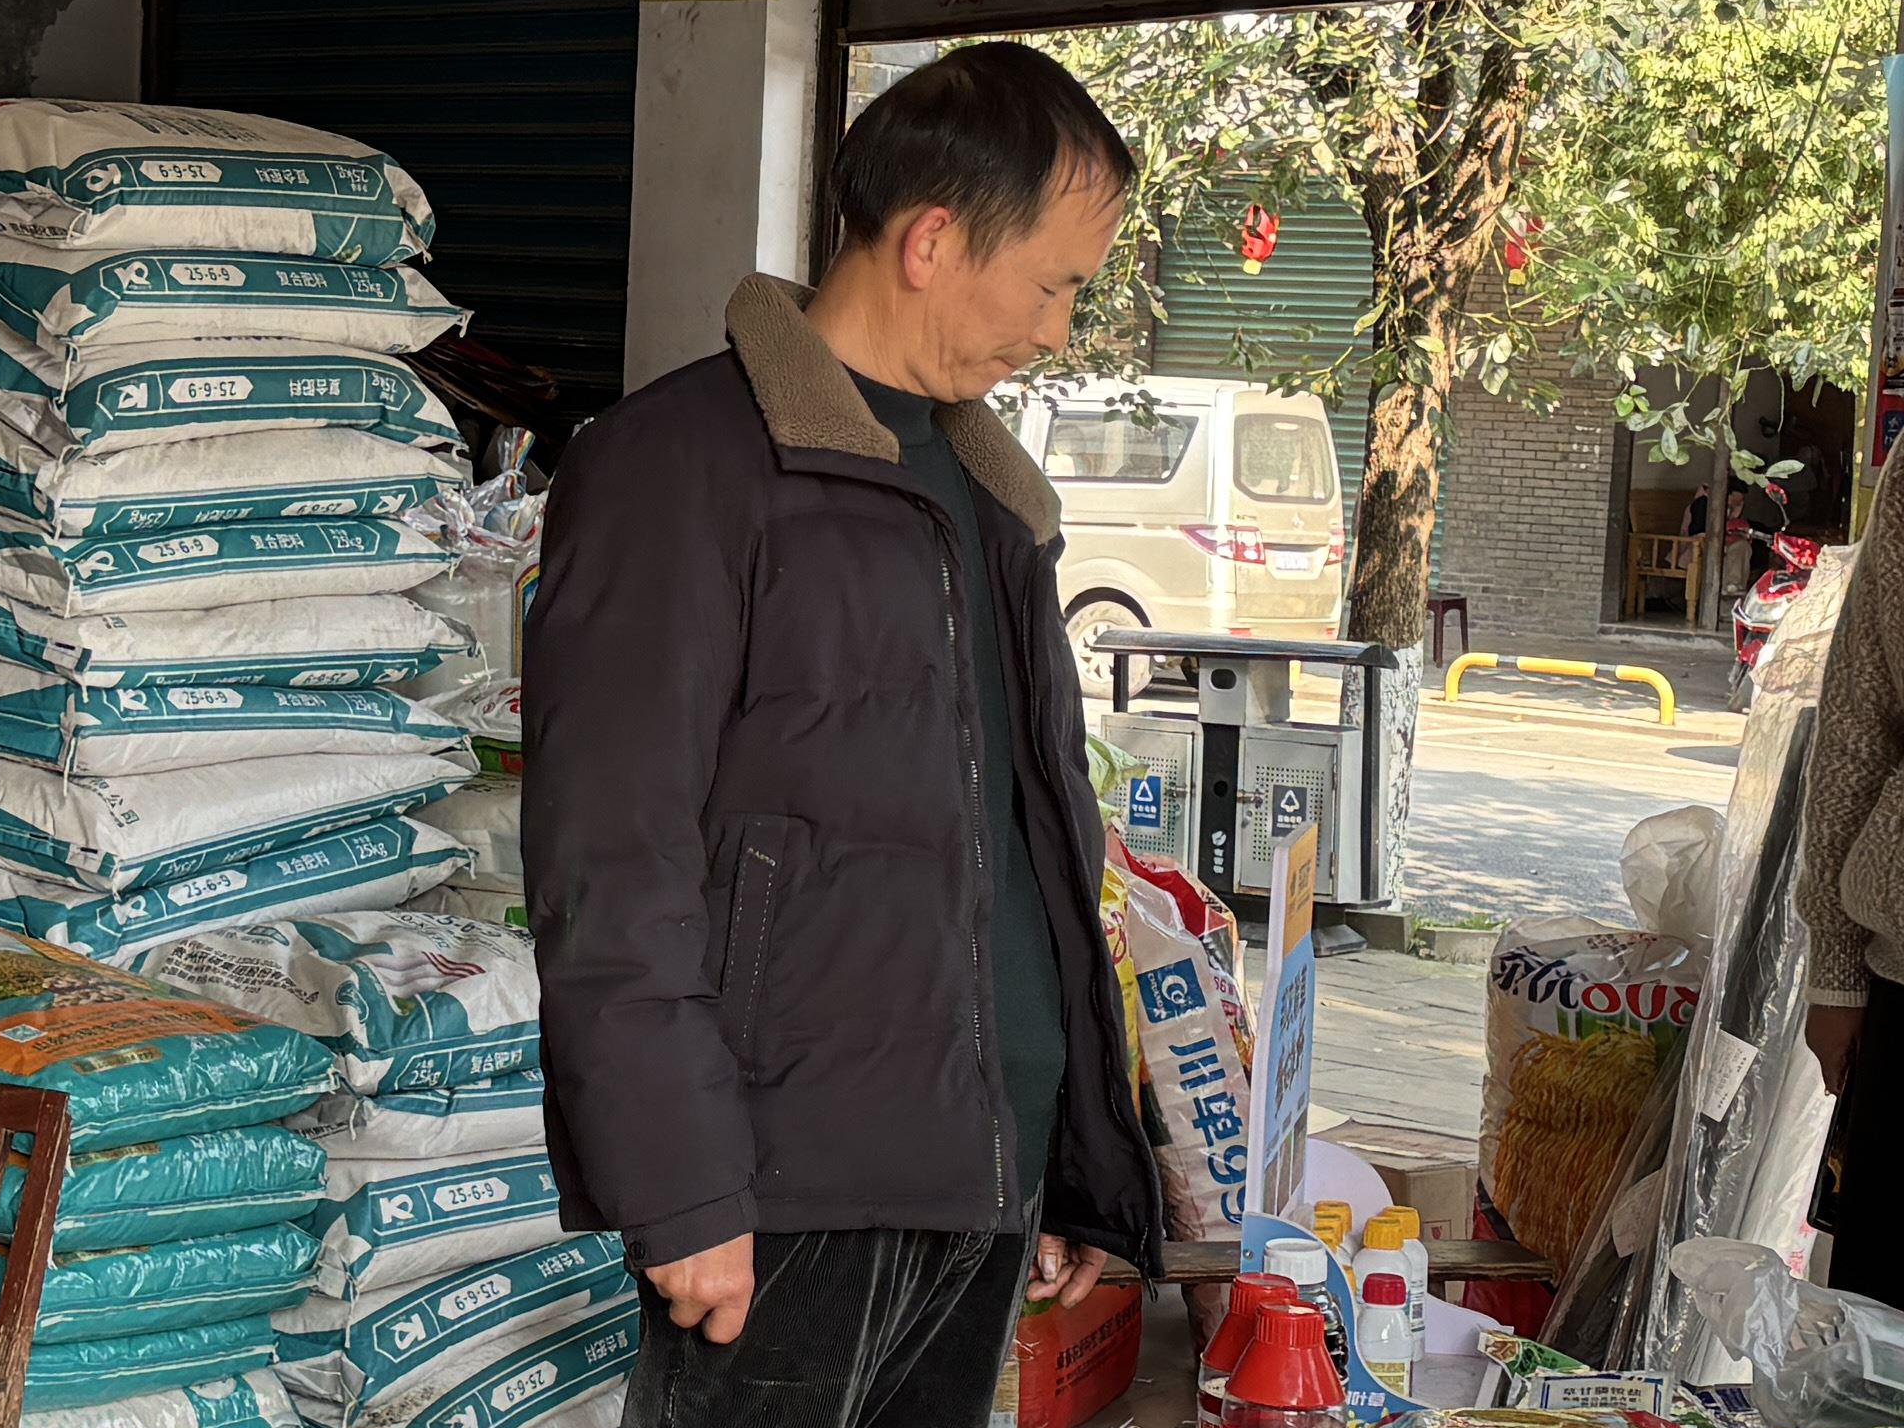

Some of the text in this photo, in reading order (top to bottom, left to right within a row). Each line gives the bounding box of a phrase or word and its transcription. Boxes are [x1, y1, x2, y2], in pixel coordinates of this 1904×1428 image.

[158, 163, 206, 180] 25-6-9
[255, 167, 310, 185] 复合肥料
[186, 264, 232, 284] 25-6-9
[187, 380, 237, 397] 25-6-9
[288, 378, 341, 396] 复合肥料
[155, 537, 204, 558] 25-6-9
[185, 876, 232, 899] 25-6-9
[448, 1184, 496, 1205] 25-6-9
[454, 1248, 587, 1312] 复合肥料 25-6-9
[504, 1329, 630, 1405] 复合肥料 25-6-9
